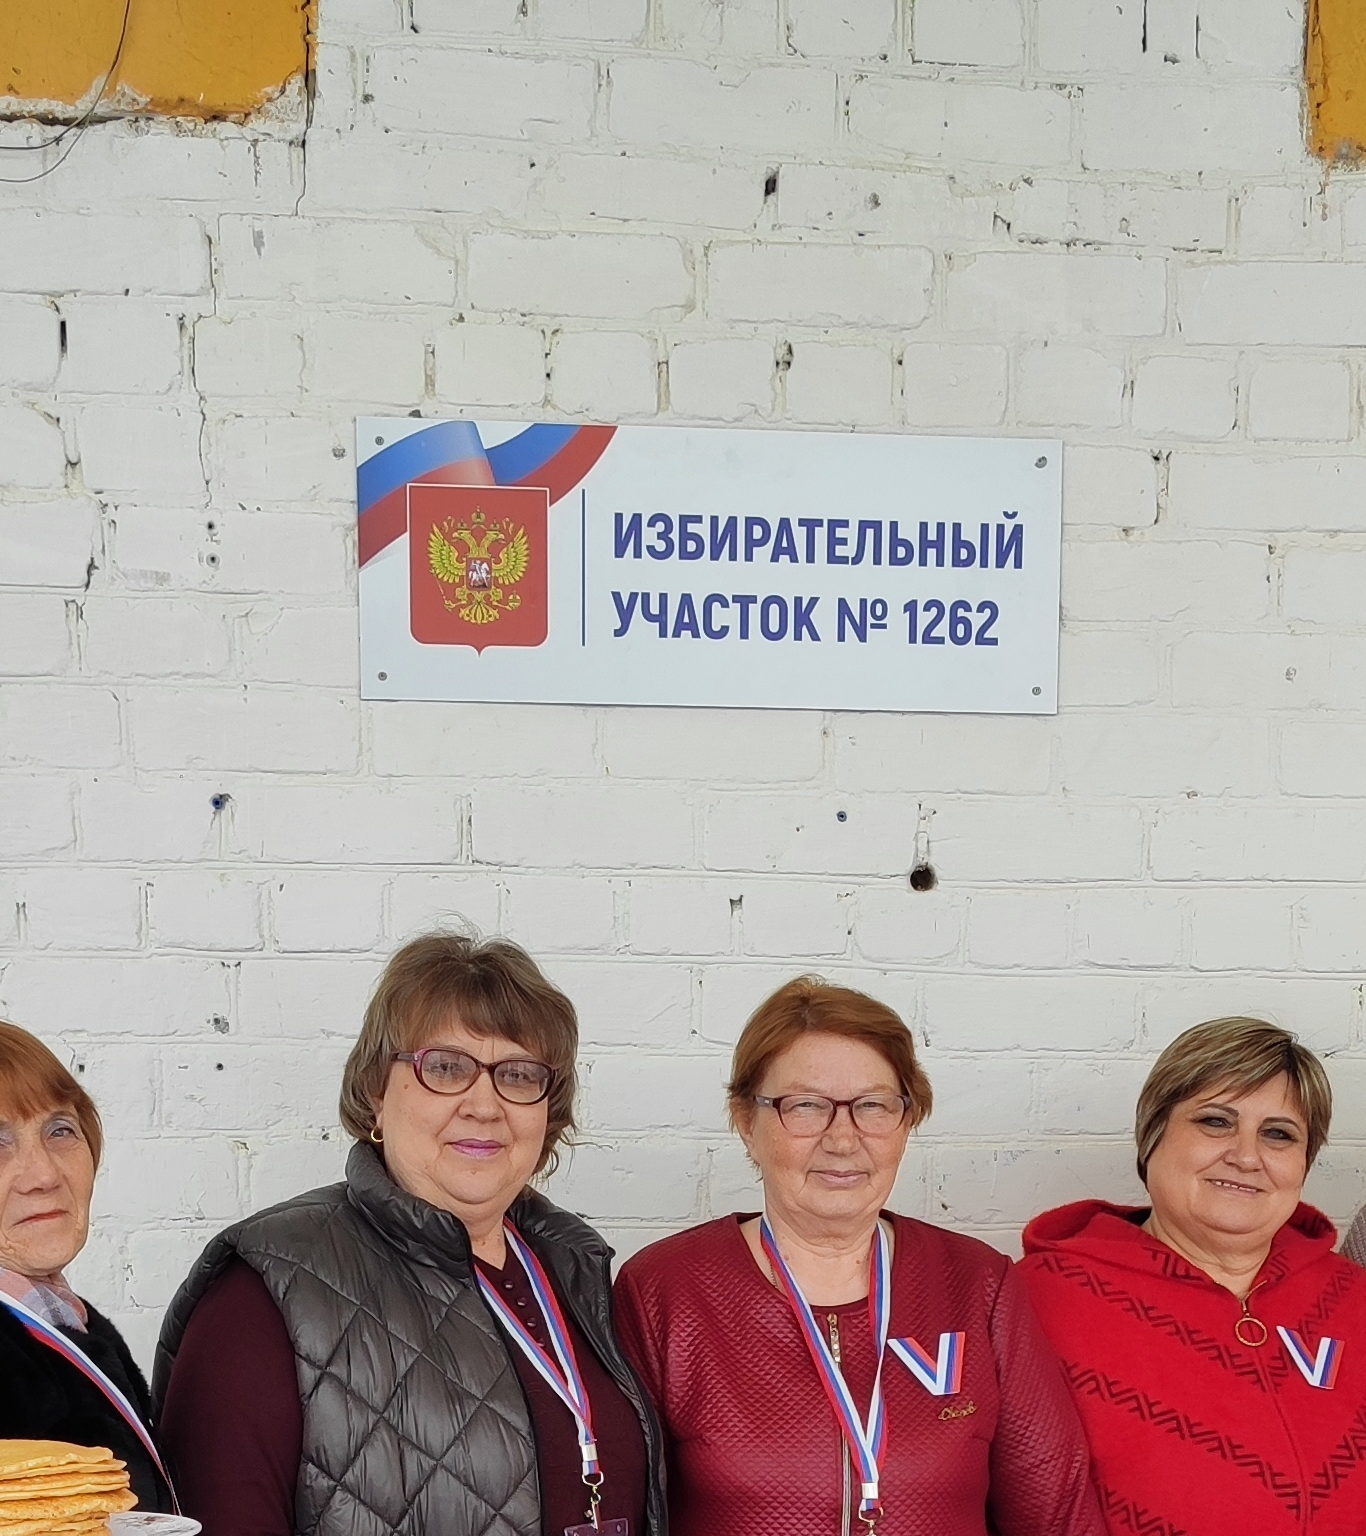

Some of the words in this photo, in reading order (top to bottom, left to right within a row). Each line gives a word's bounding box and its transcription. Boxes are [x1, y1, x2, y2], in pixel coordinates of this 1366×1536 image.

[613, 509, 1025, 571] ИЗБИРАТЕЛЬНЫЙ
[611, 590, 822, 643] УЧАСТОК
[837, 597, 889, 645] №
[902, 598, 999, 647] 1262
